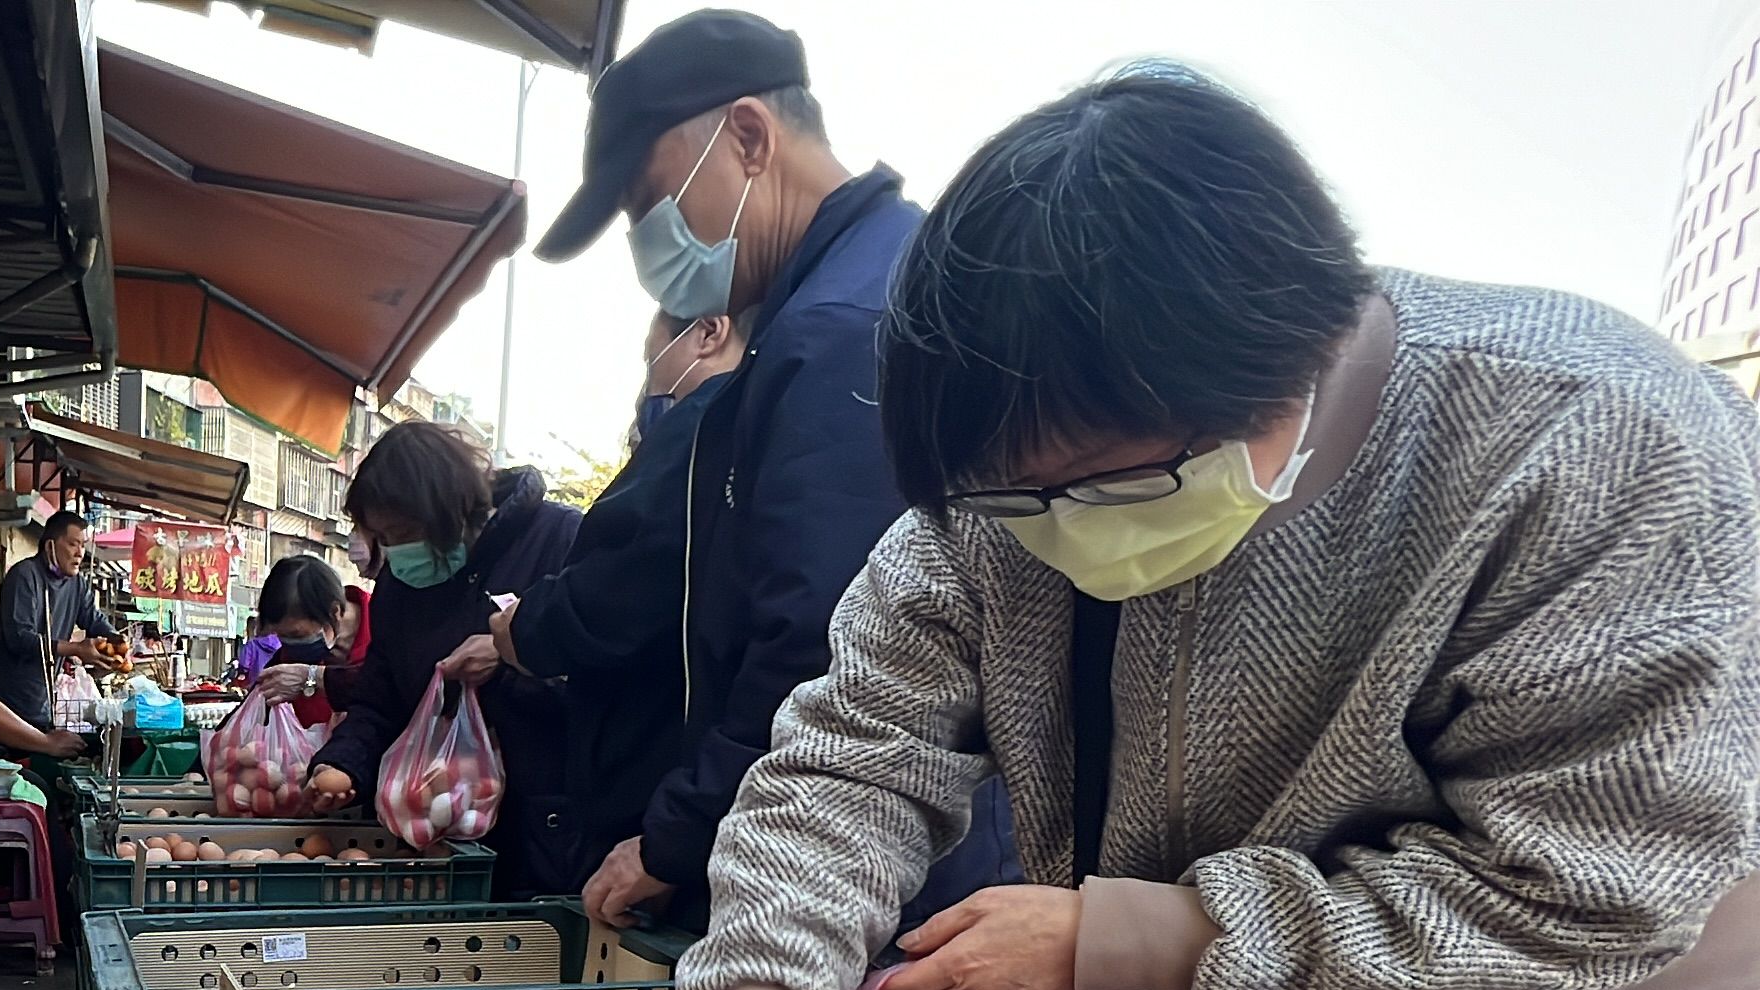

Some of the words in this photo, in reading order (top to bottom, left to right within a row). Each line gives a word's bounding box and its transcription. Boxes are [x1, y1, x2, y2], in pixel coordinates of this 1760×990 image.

[155, 527, 215, 547] 古早味
[136, 567, 224, 596] 碳烤地瓜
